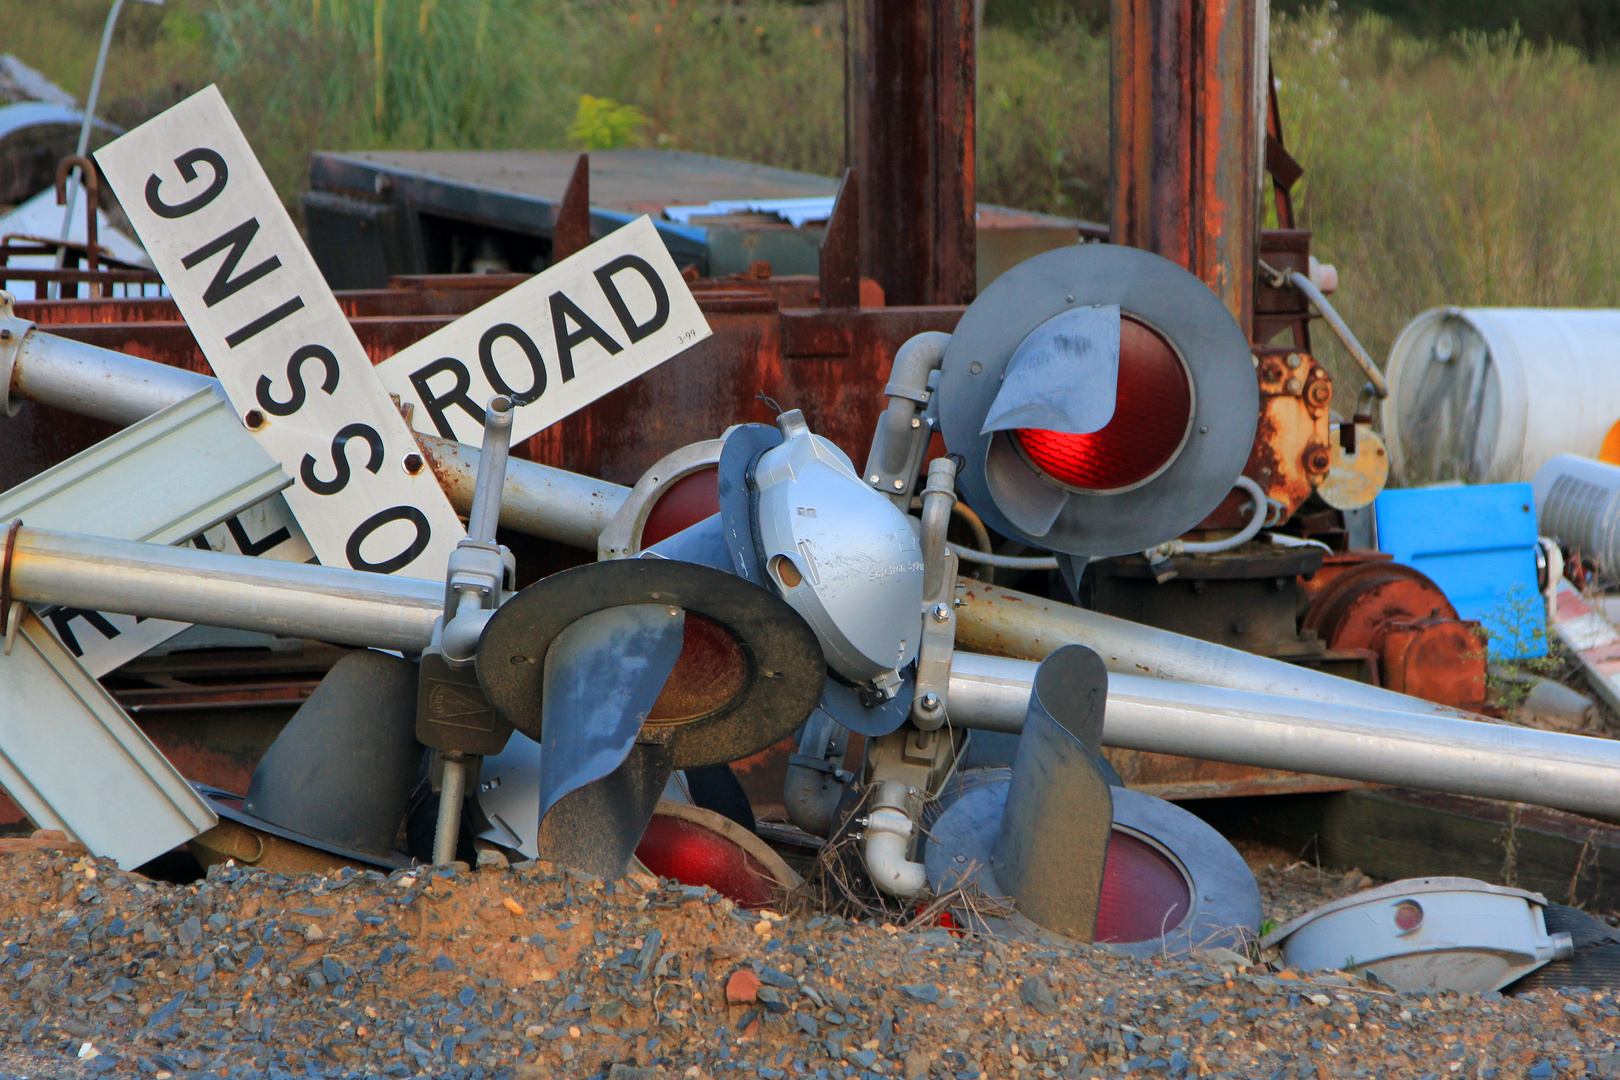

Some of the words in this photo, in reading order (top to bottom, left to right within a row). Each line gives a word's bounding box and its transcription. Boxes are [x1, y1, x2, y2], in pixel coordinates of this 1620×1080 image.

[144, 147, 432, 575] OSSING
[408, 253, 670, 443] ROAD
[677, 329, 696, 345] 3-99
